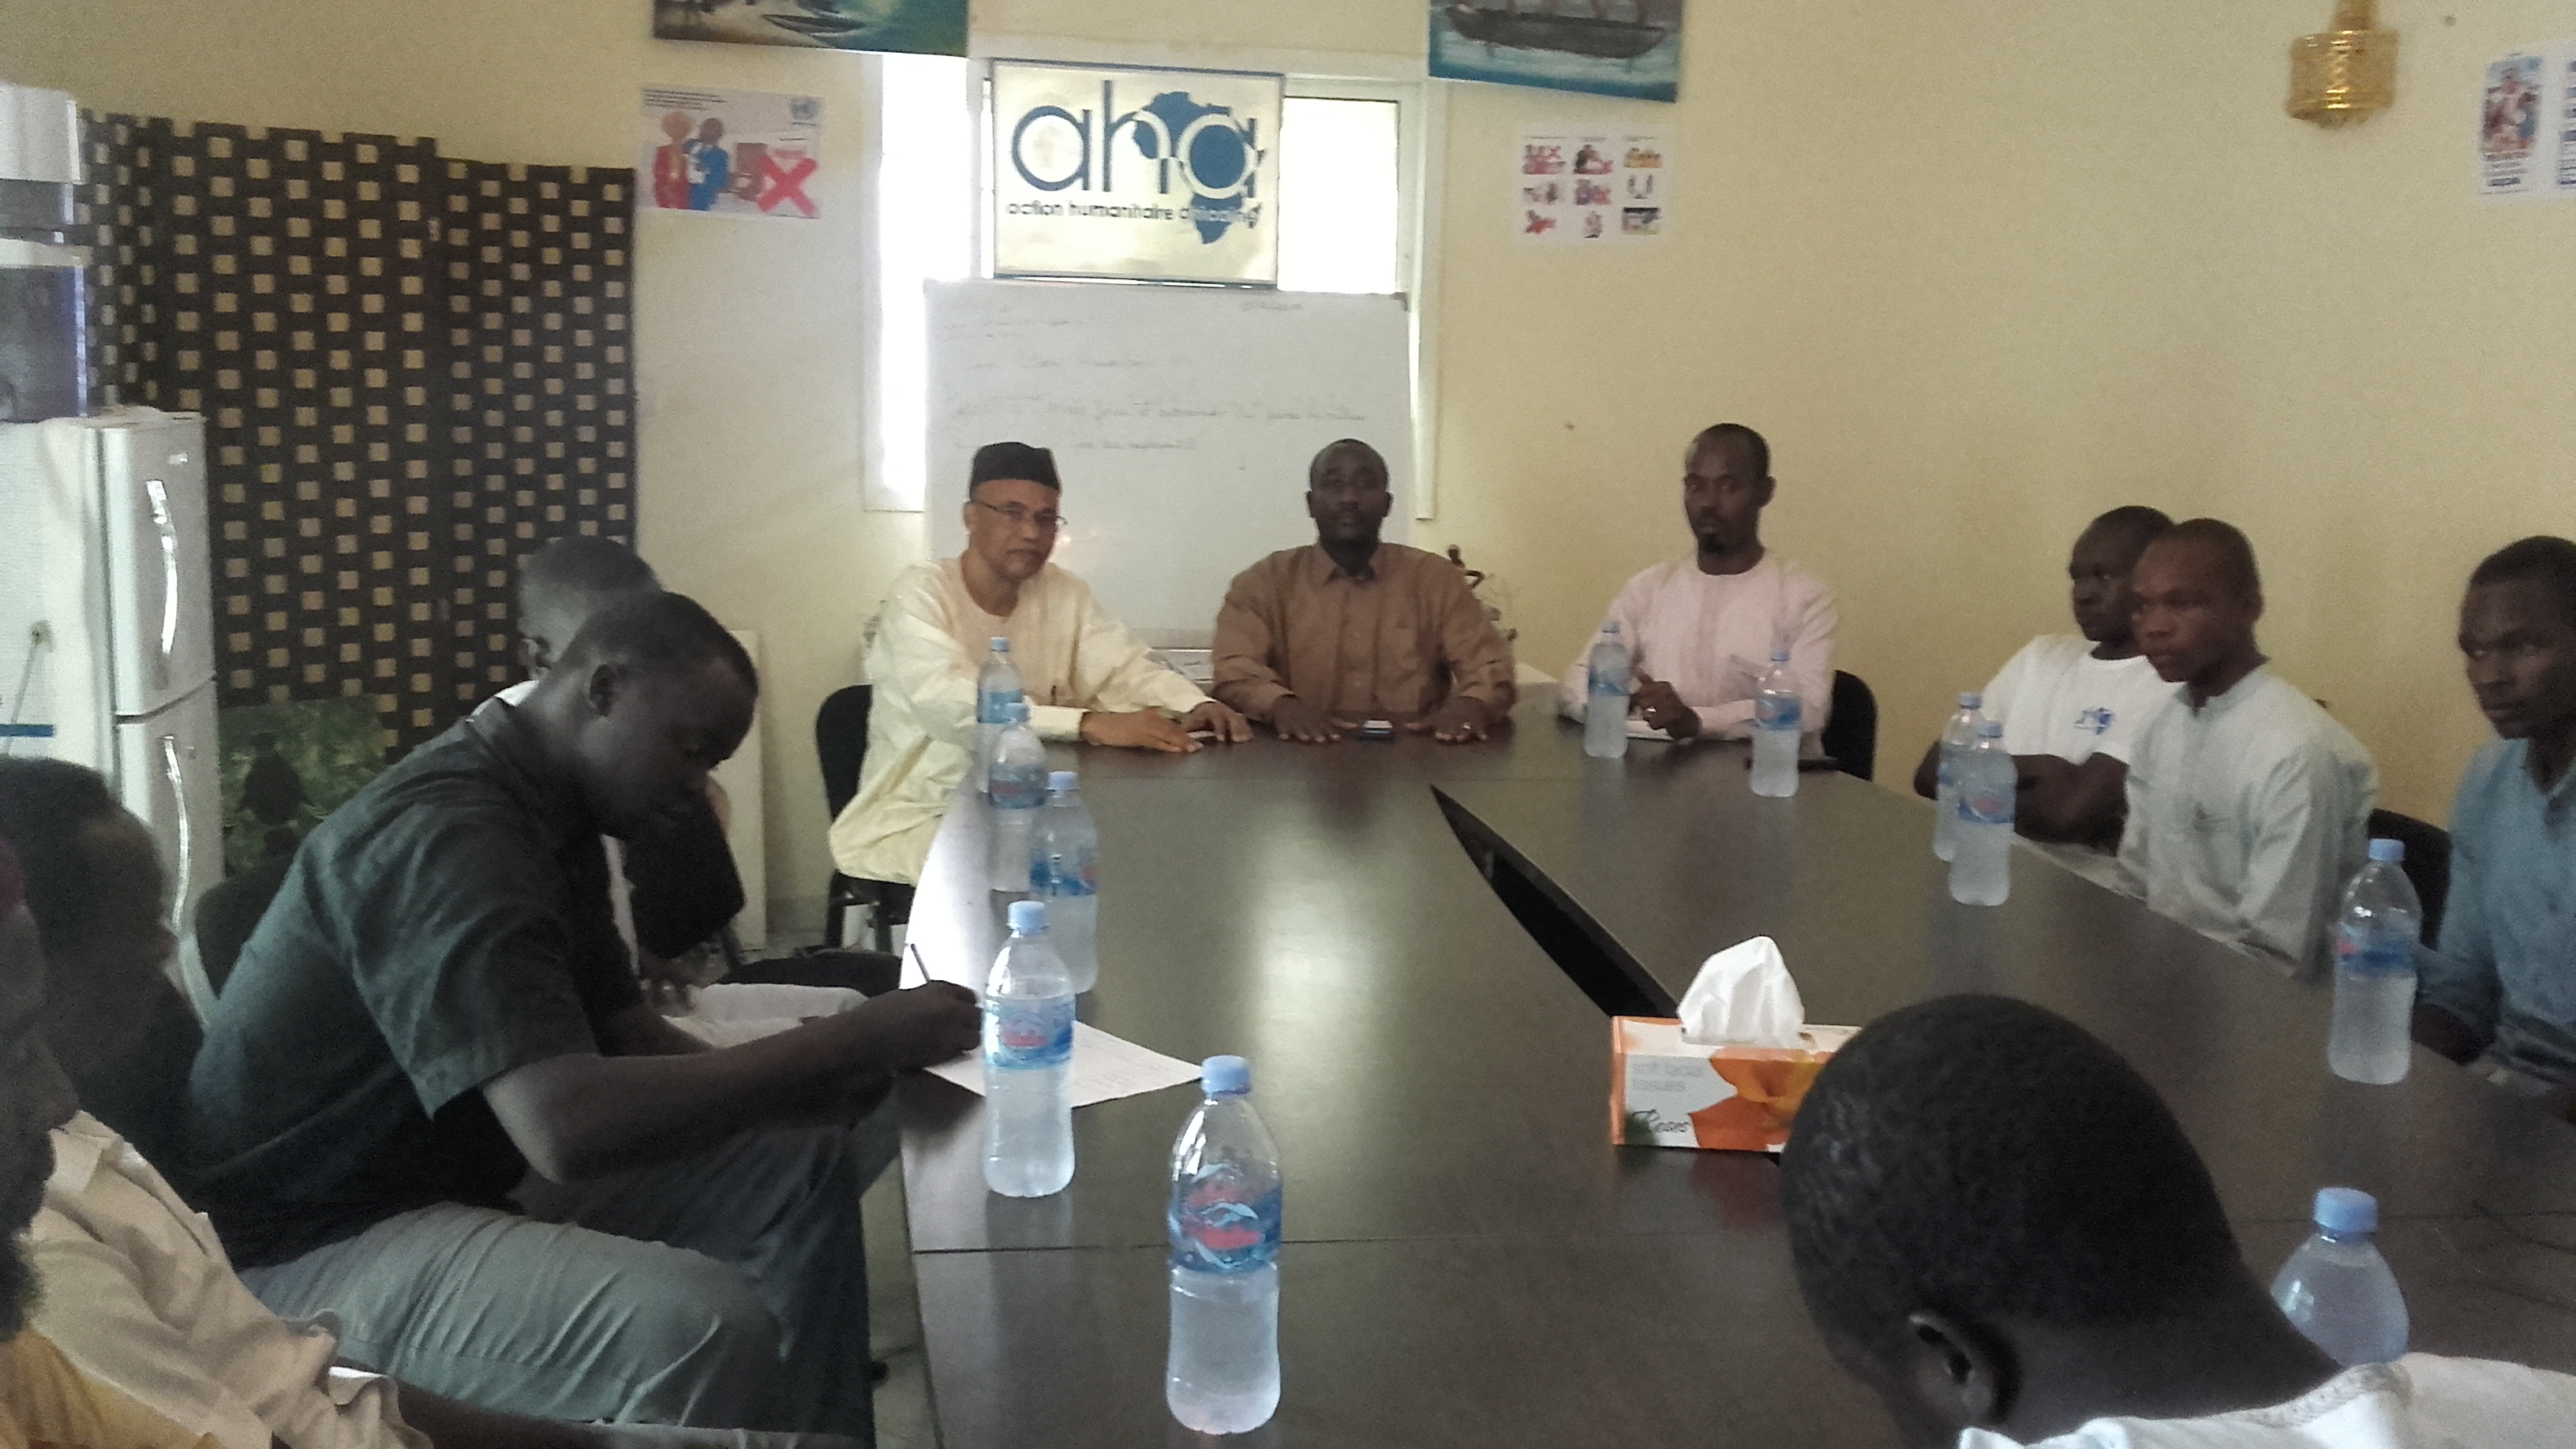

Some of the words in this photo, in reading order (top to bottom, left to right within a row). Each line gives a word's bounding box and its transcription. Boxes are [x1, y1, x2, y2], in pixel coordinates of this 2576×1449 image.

[1011, 79, 1256, 199] aha
[1007, 200, 1064, 215] action
[1069, 200, 1173, 220] humanitaire
